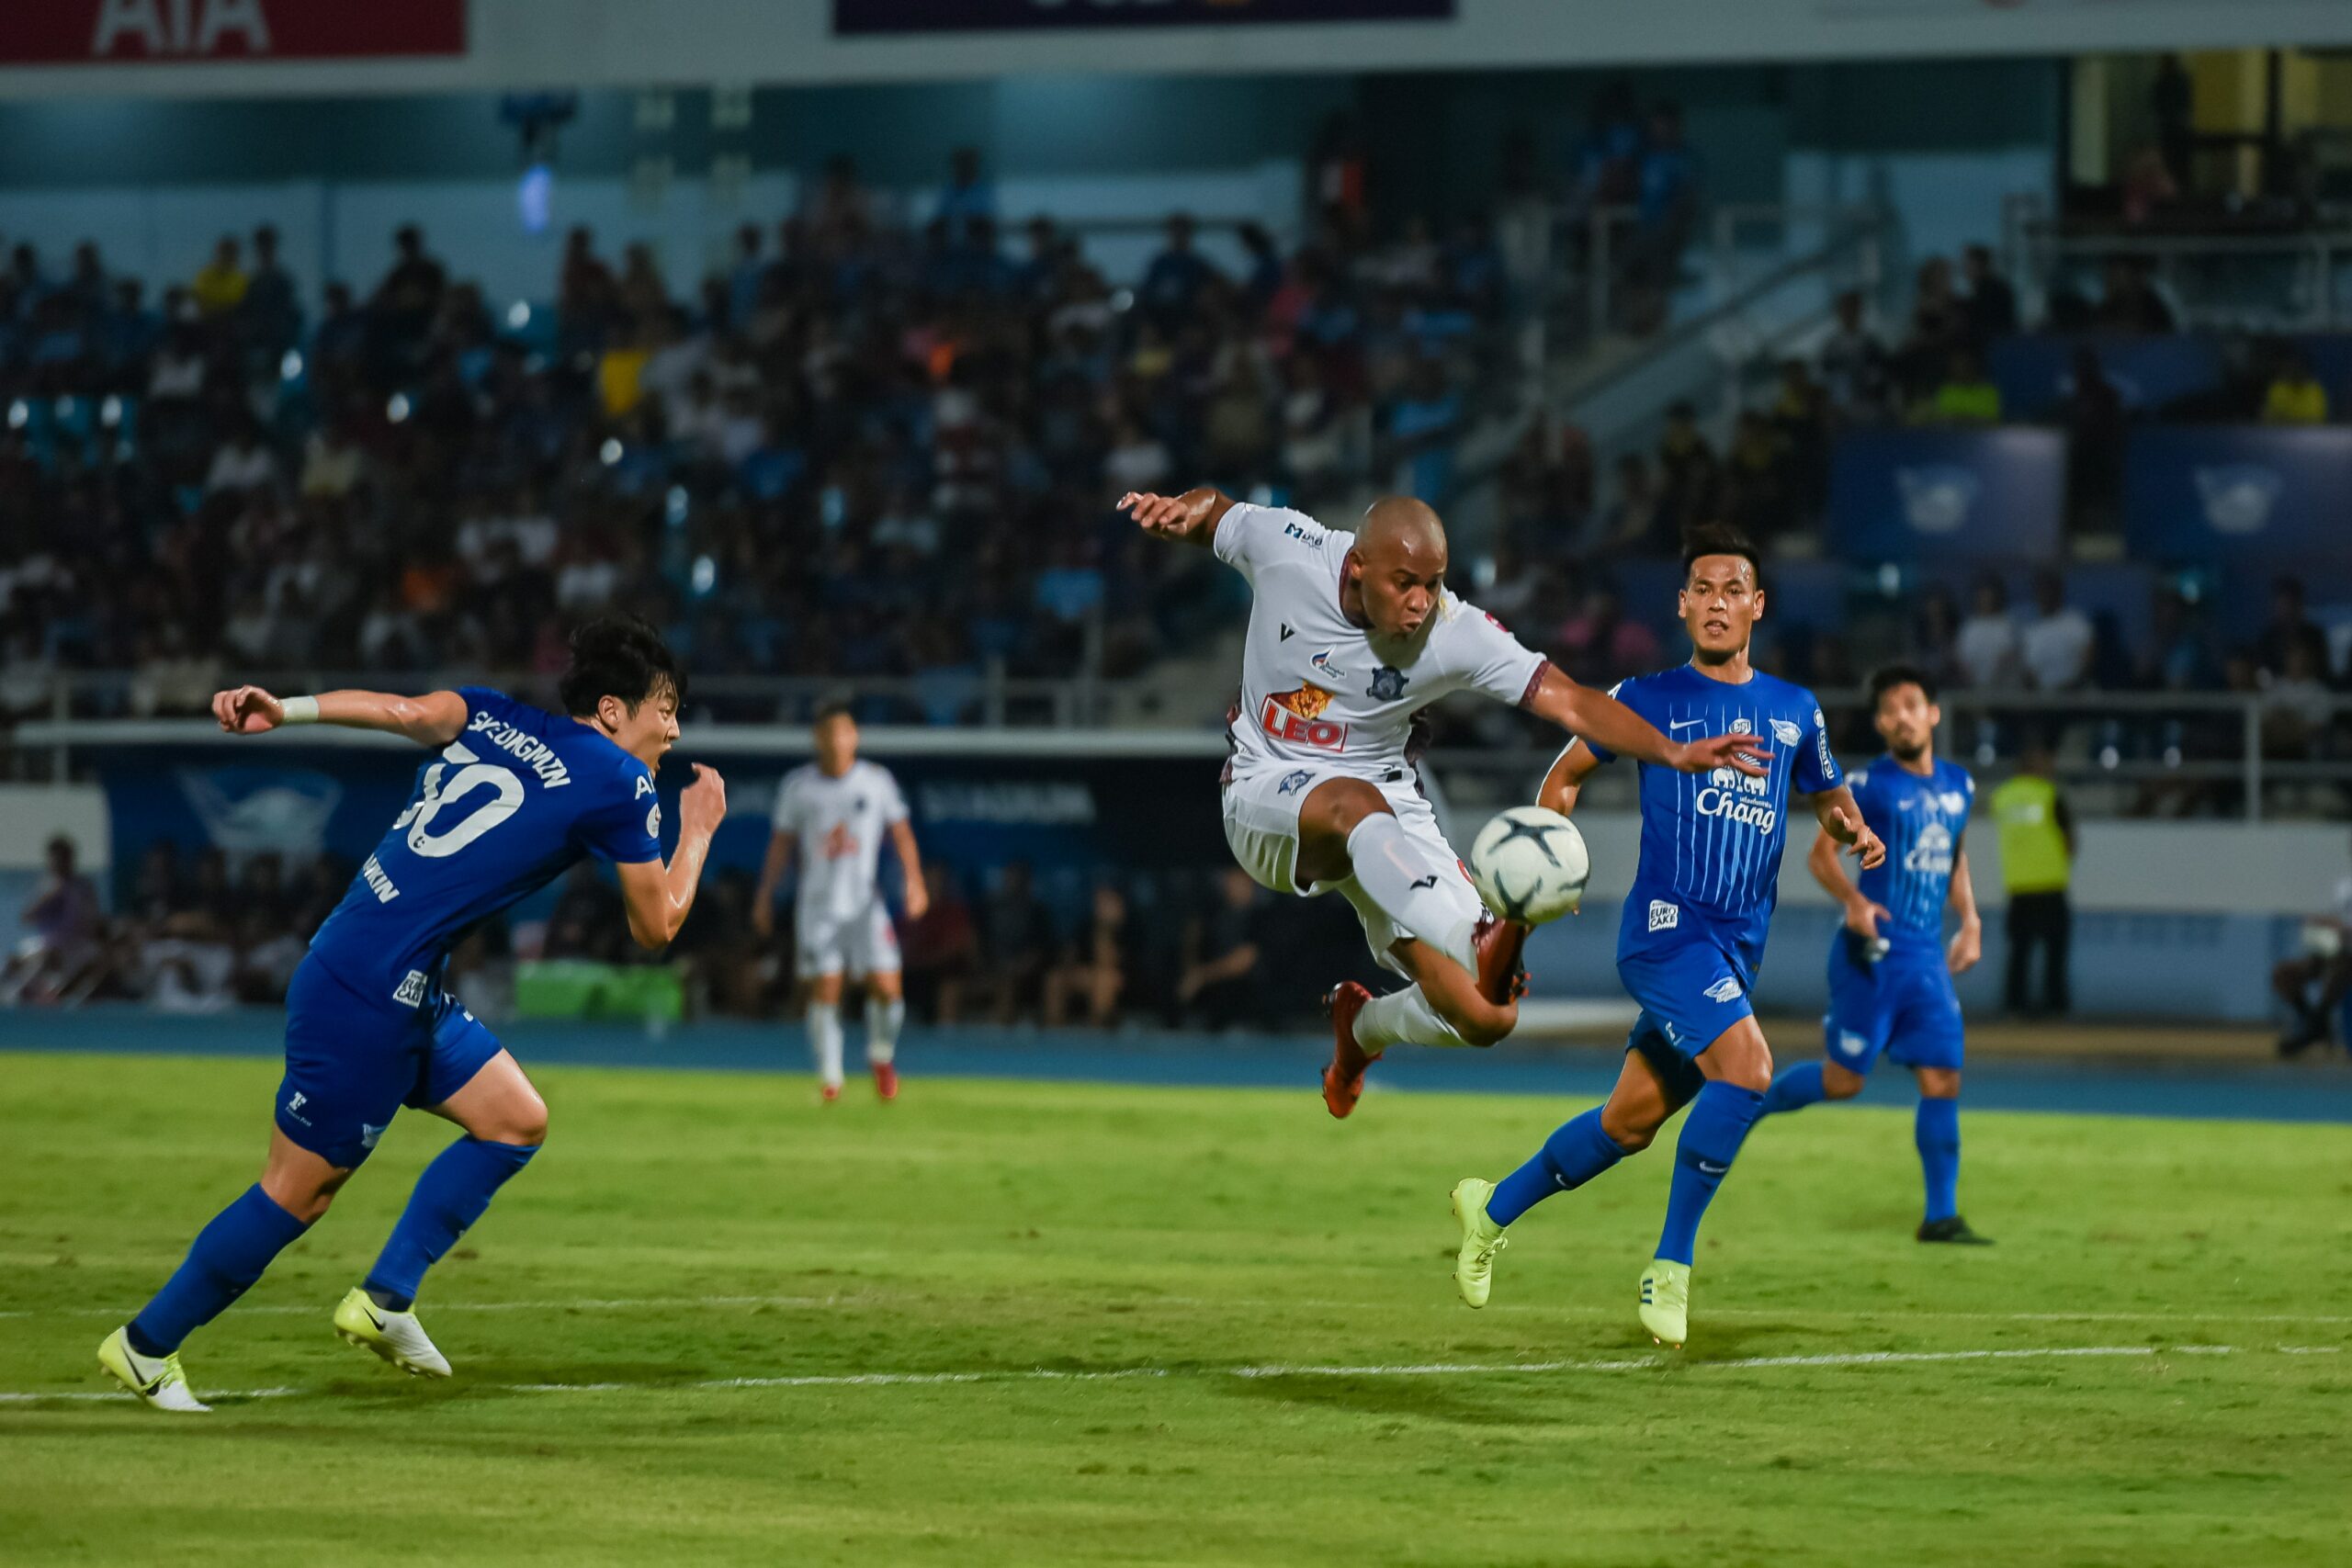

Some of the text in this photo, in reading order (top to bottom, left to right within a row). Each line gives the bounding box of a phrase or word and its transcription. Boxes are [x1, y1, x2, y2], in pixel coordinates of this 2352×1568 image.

[1262, 701, 1342, 746] LEO
[1696, 787, 1775, 836] Chang
[1904, 849, 1951, 875] Chan
[1650, 914, 1675, 928] CAKE
[1651, 907, 1676, 919] EURO
